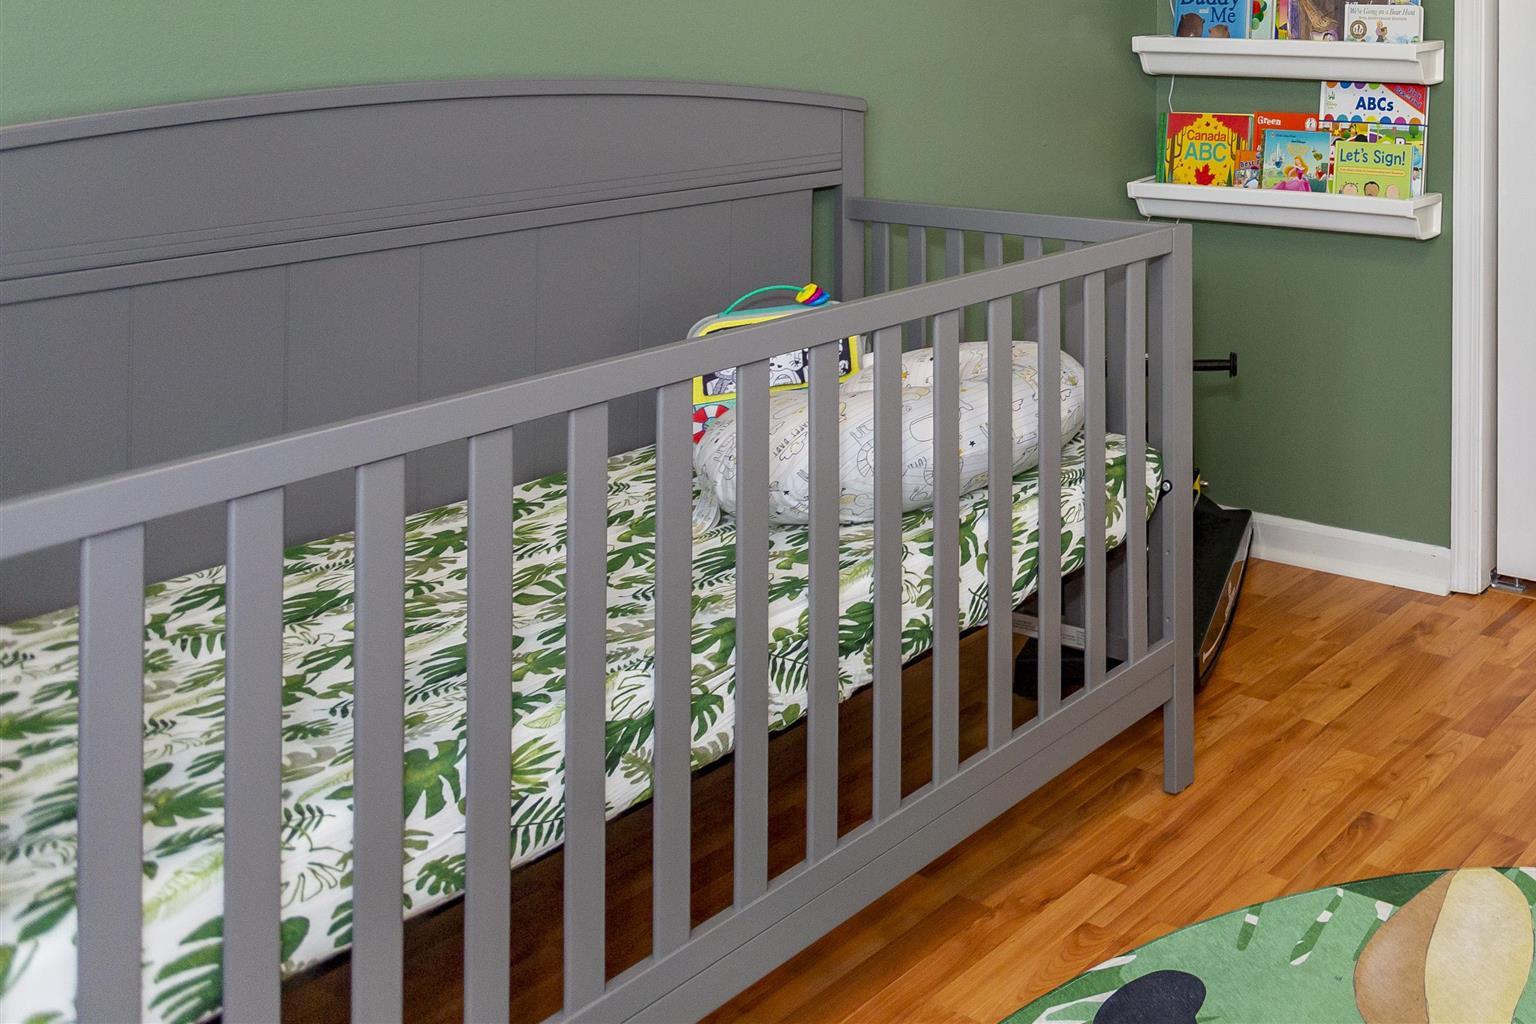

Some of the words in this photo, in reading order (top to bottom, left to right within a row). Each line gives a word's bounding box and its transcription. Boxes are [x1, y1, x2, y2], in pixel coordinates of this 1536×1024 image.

[1209, 7, 1237, 24] Me
[1355, 96, 1394, 112] ABCs
[1257, 115, 1282, 126] Green
[1186, 129, 1227, 142] Canada
[1184, 141, 1227, 163] ABC
[1340, 147, 1369, 163] Let's
[1373, 149, 1406, 167] Sign!
